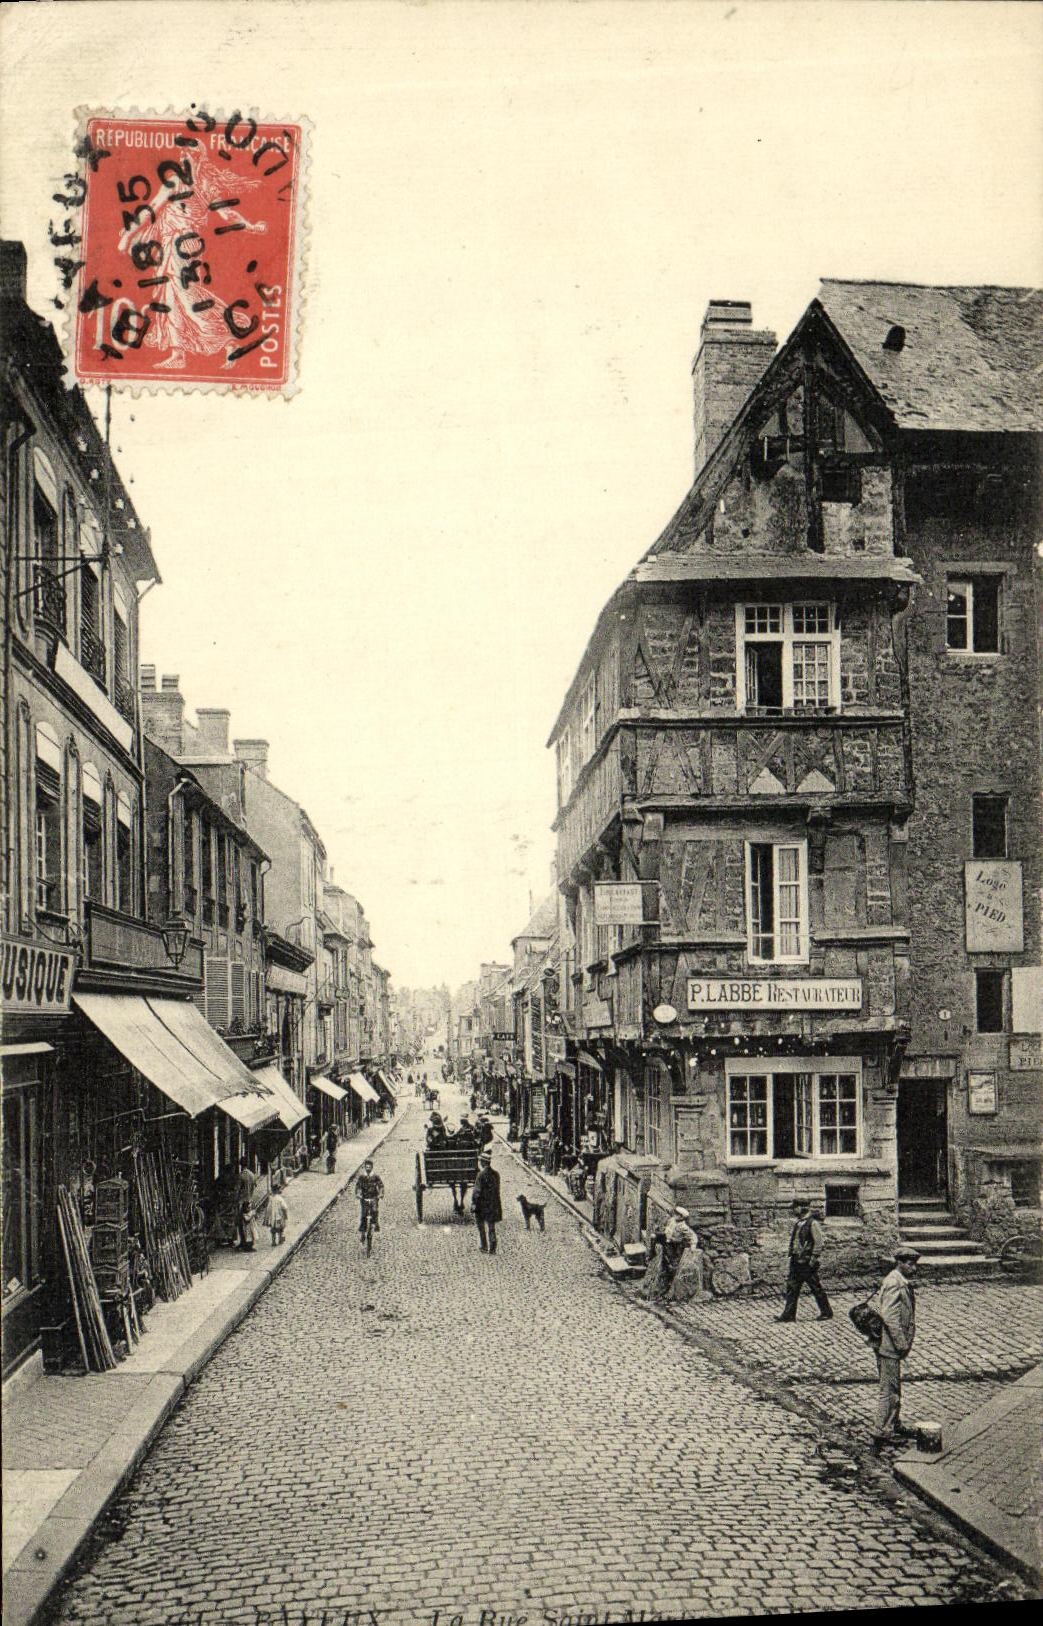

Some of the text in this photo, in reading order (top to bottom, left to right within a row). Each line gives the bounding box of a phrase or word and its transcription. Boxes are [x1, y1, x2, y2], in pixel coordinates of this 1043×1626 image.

[259, 284, 283, 368] POSTES
[975, 902, 1006, 923] PIED
[0, 941, 69, 1006] USIQUE
